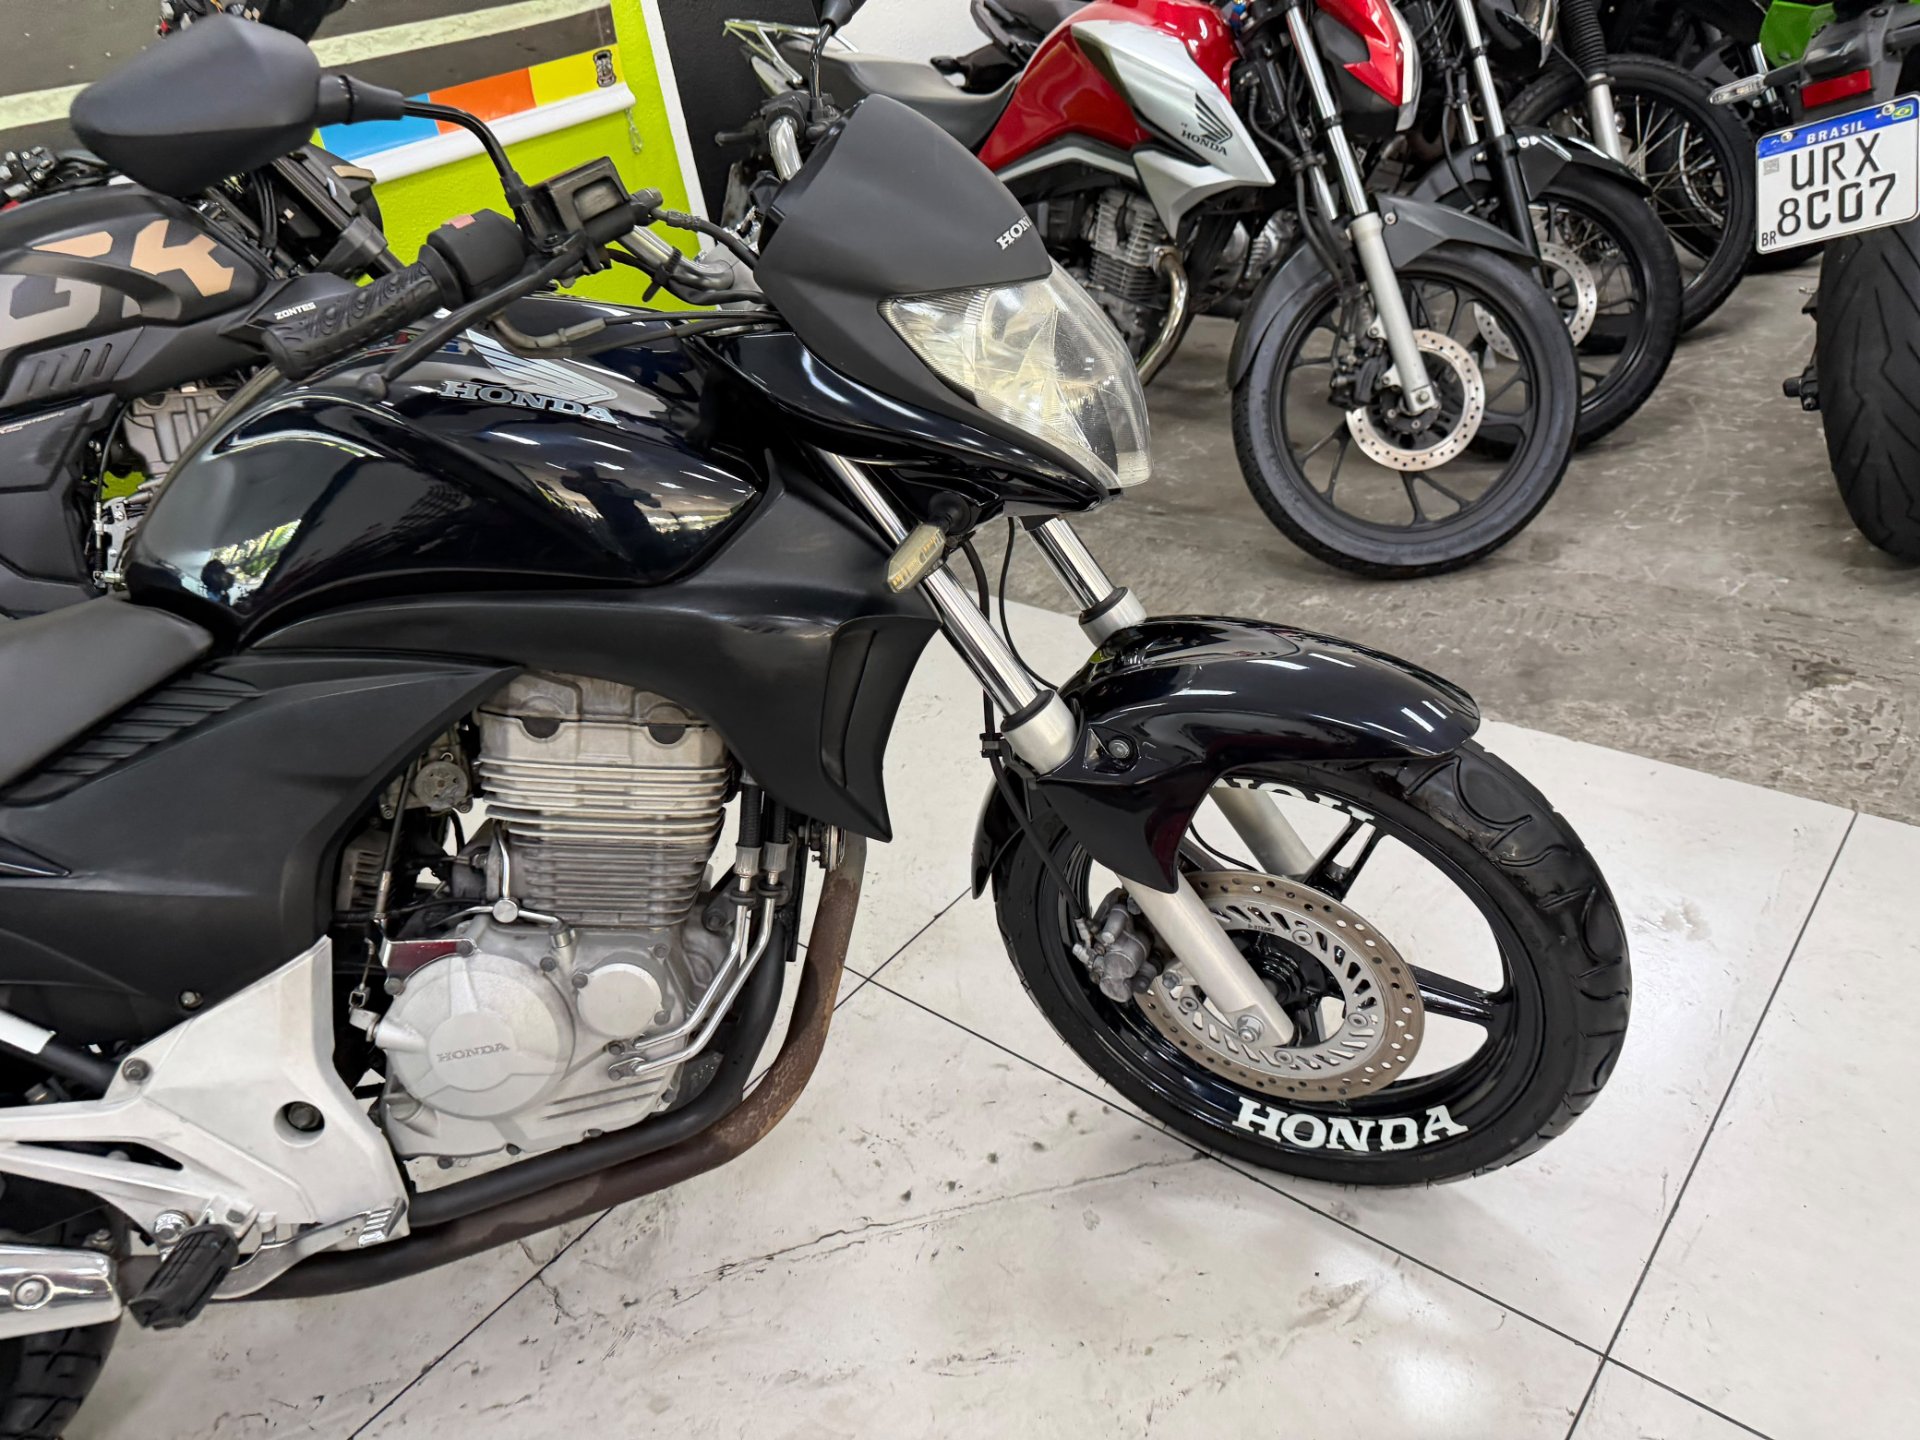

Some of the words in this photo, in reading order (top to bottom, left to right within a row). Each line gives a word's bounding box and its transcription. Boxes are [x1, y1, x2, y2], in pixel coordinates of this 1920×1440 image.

[1181, 129, 1228, 157] HONDA
[1806, 120, 1866, 145] BRASIL
[1791, 132, 1881, 191] URX
[1777, 173, 1896, 237] 8C07
[996, 215, 1033, 251] HON
[1761, 230, 1777, 247] BR
[274, 302, 317, 320] ZONTES
[438, 380, 625, 428] HONDA
[436, 1042, 510, 1063] HONDA
[1231, 1096, 1470, 1153] HONDA
